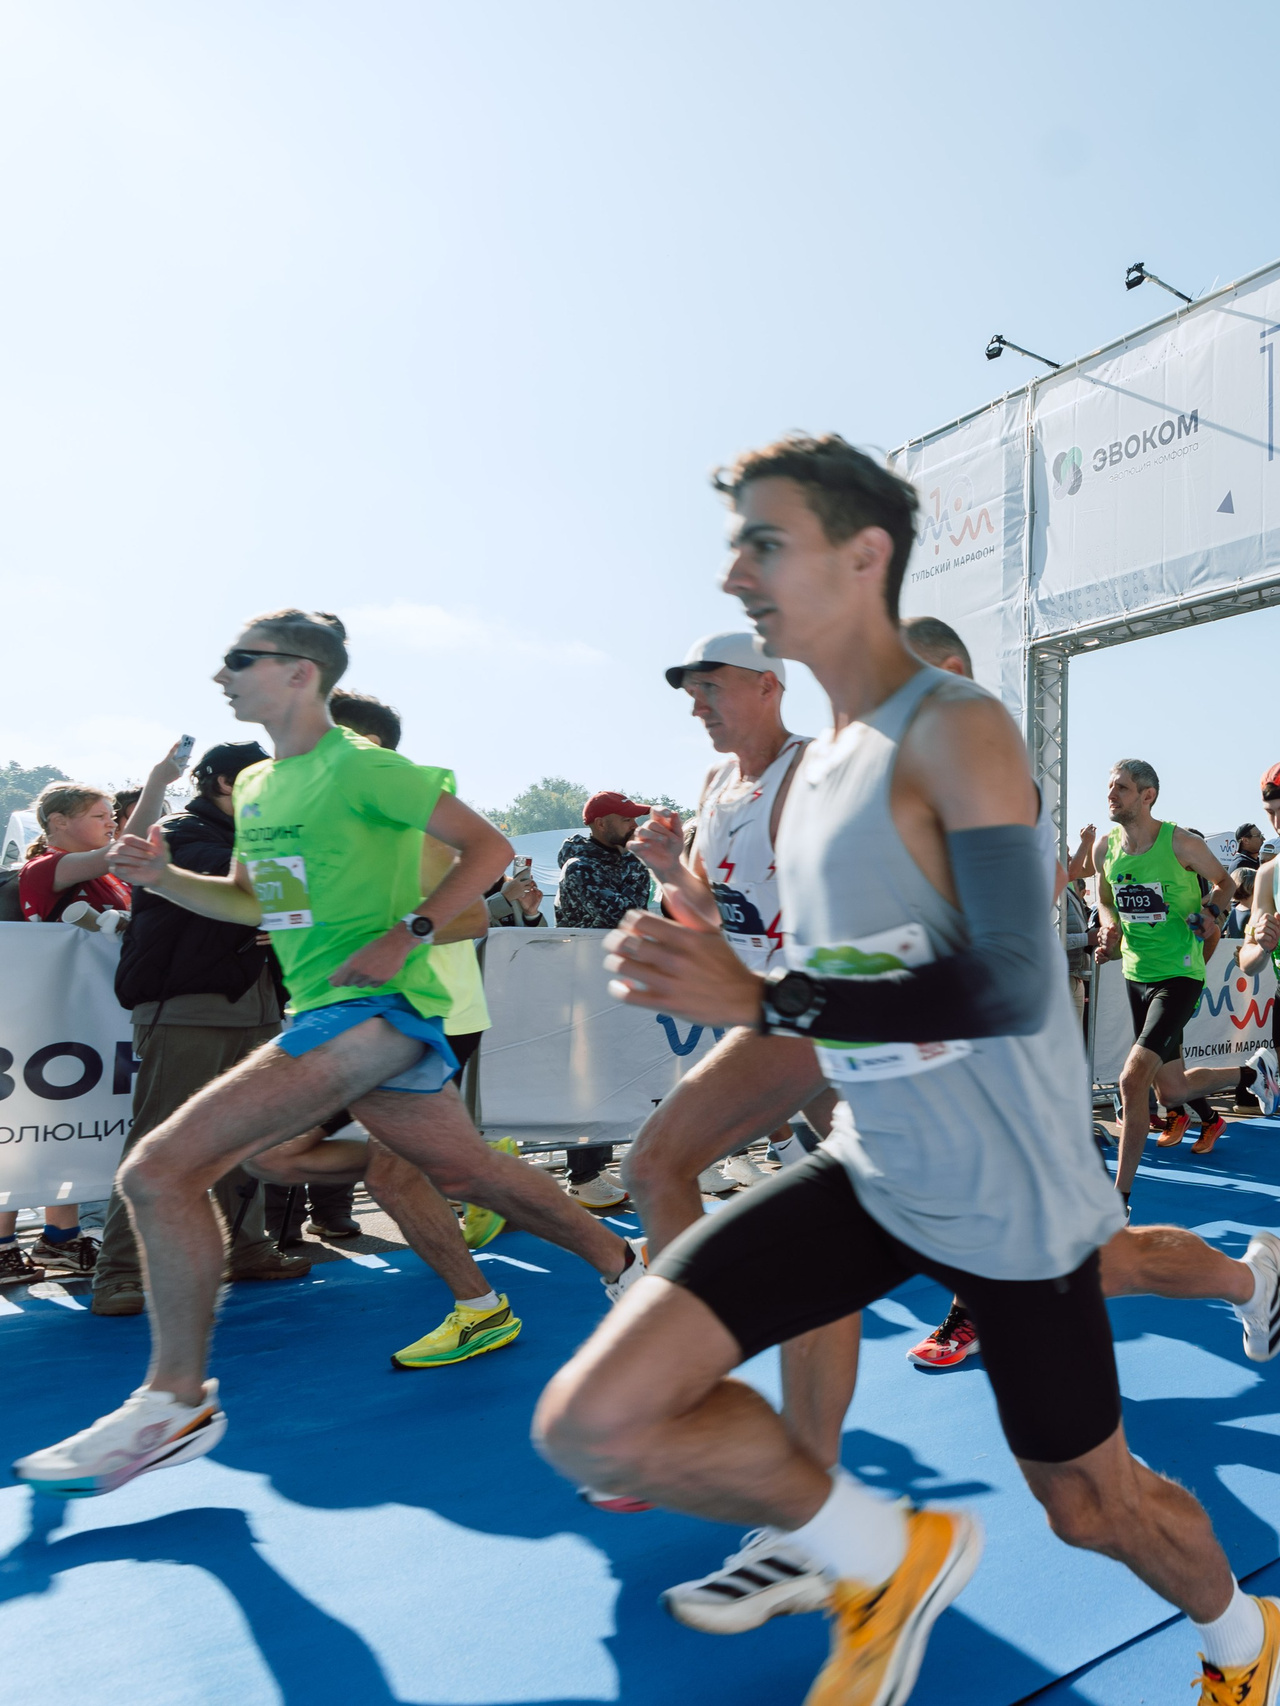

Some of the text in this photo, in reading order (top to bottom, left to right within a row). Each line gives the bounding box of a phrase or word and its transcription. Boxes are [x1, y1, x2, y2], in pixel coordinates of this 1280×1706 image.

[1092, 409, 1199, 473] ЭВОКОМ
[911, 545, 995, 583] ТУЛЬСКИЙ МАРАФОН
[1123, 895, 1151, 908] 7193
[1182, 1040, 1232, 1059] УЛЬСКИЙ
